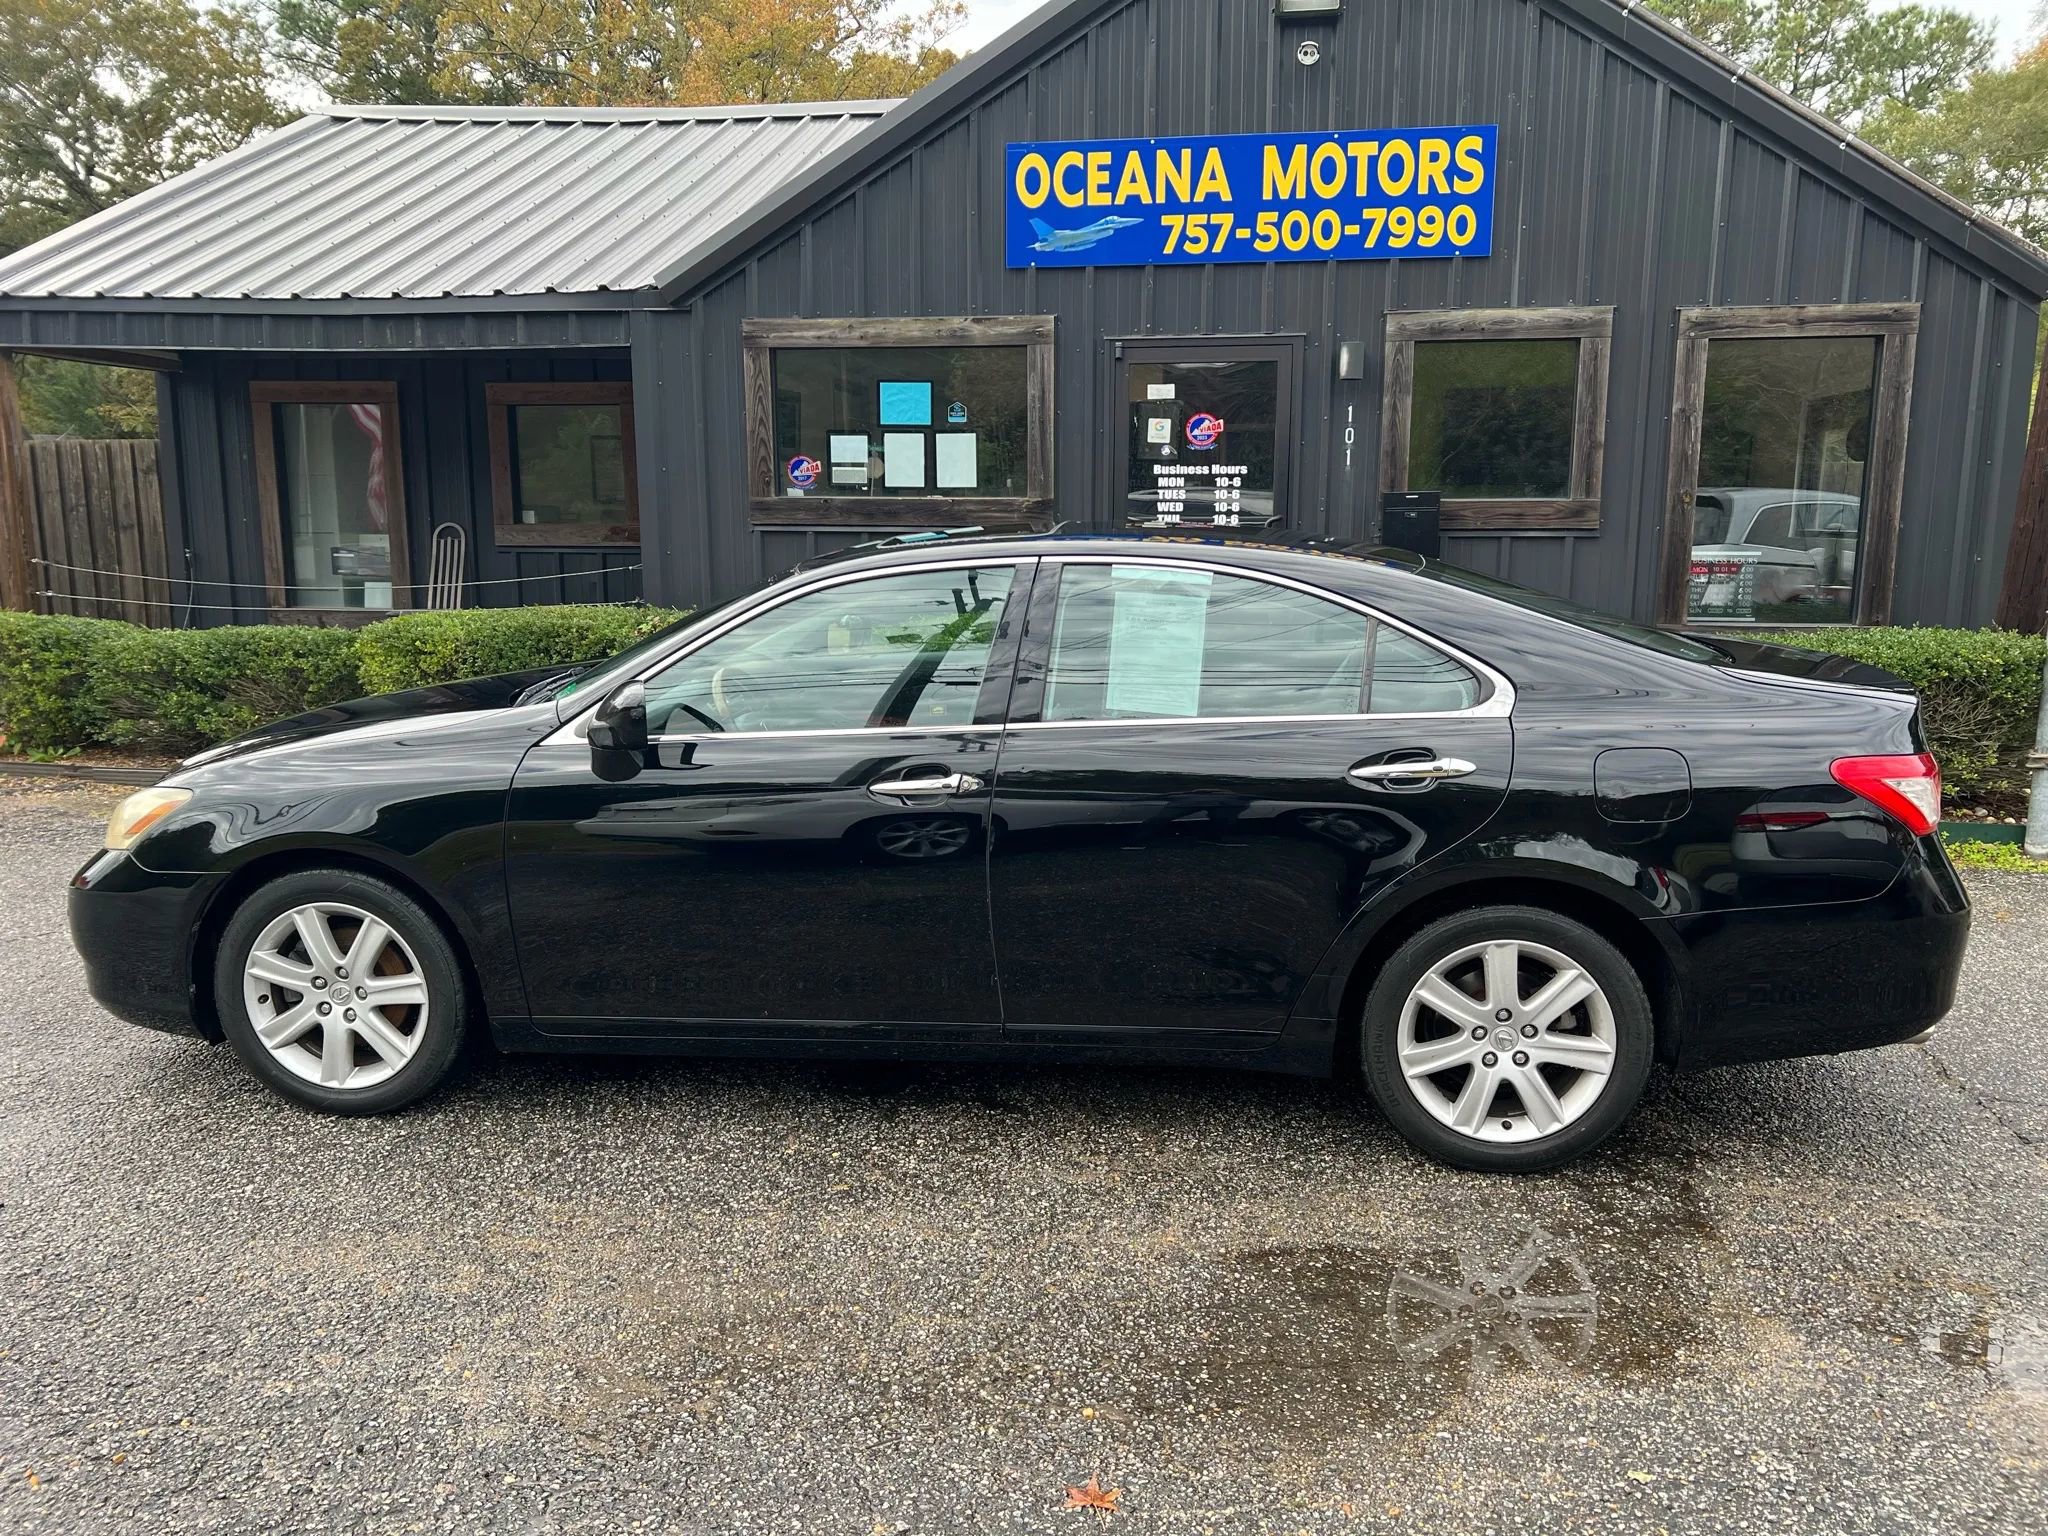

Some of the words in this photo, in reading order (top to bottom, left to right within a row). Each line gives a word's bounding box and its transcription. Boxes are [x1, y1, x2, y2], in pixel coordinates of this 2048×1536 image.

[1015, 147, 1232, 209] OCEANA
[1263, 135, 1484, 200] MOTORS
[1160, 204, 1478, 254] 757-500-7990
[1153, 464, 1210, 475] Business
[1211, 464, 1248, 475] Hours
[1157, 477, 1185, 487] MON
[1214, 477, 1242, 487] 10-6
[1157, 489, 1186, 500] TUES
[1213, 489, 1241, 500] 10-6
[1156, 502, 1184, 512] WED
[1213, 502, 1240, 512] 10-6
[1212, 514, 1239, 525] 10-6
